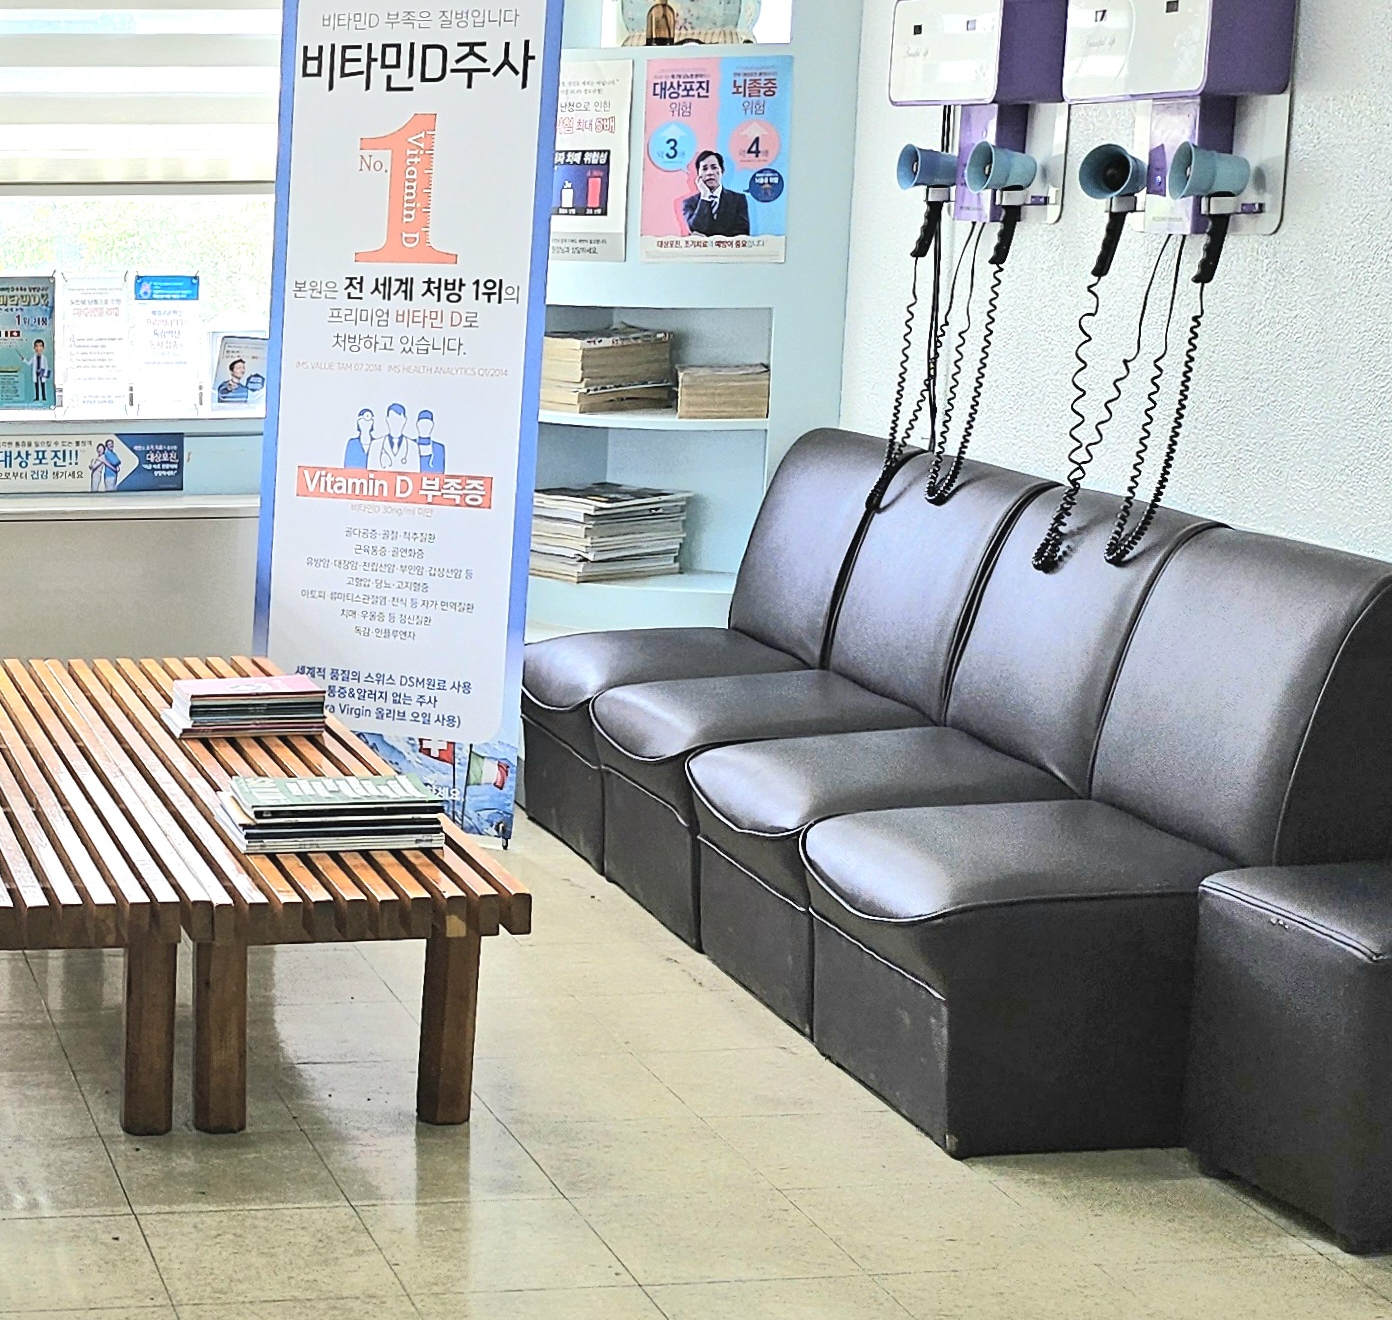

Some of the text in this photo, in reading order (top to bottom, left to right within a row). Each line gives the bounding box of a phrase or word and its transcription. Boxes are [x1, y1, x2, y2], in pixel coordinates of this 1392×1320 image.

[322, 8, 520, 30] 비타민D 부족은 질병입니다
[302, 39, 536, 92] 비타민D주사
[652, 79, 710, 99] 대상포진
[731, 78, 778, 98] 뇌졸중
[669, 101, 692, 117] 위험
[742, 99, 766, 115] 위험
[358, 155, 388, 173] No.
[401, 131, 426, 248] Vitamin D
[293, 276, 521, 305] 본원은 전 세계 처방 1위의
[328, 307, 479, 329] 프리미엄 비타민 D로
[332, 333, 467, 356] 처방하고 있습니다.
[310, 362, 334, 371] VALUE
[402, 366, 432, 375] HEALTH
[434, 367, 476, 376] ANALYTICS
[30, 469, 49, 480] 건강
[303, 469, 487, 507] Vitamin D 부족증
[330, 668, 361, 683] 품질의
[364, 671, 396, 686] 스위스
[400, 675, 448, 691] DSM원료
[450, 680, 473, 695] 사용
[392, 692, 413, 707] 없는
[416, 694, 438, 708] 주사
[339, 702, 372, 719] Virgin
[375, 707, 407, 721] 올리브
[410, 711, 431, 725] 오일
[434, 714, 462, 729] 사용)
